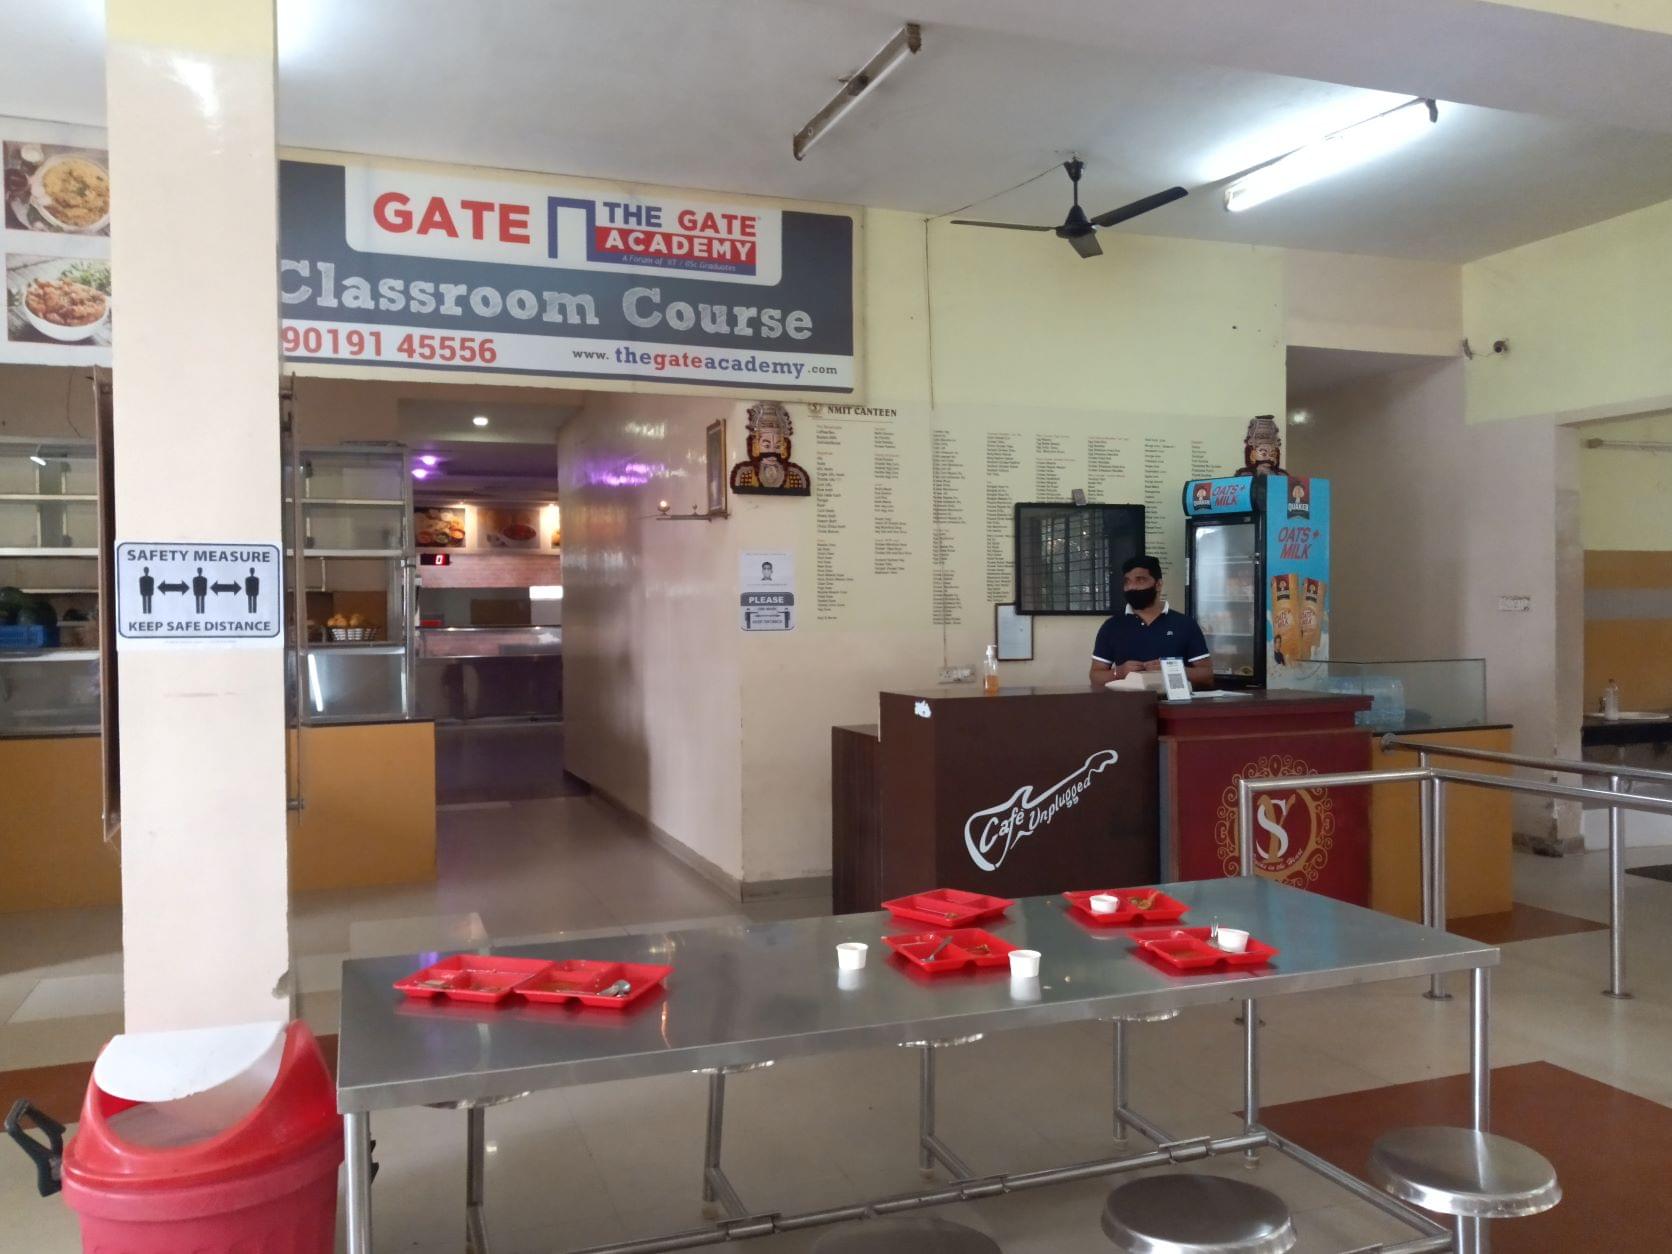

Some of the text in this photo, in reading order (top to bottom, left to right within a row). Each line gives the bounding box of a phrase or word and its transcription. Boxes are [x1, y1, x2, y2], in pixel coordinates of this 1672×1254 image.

[372, 192, 531, 245] GATE
[603, 202, 756, 238] THE GATE
[605, 229, 752, 261] ACADEMY
[281, 258, 814, 341] Classroom Course
[282, 325, 497, 364] 90191 45556
[827, 406, 853, 415] NMIT
[854, 407, 897, 417] CANTEEN
[1215, 495, 1237, 507] MILK
[1288, 503, 1309, 512] QUAKER
[127, 549, 271, 563] SAFETY MEASURE
[1280, 543, 1313, 560] MILK
[748, 596, 785, 604] PLEASE
[128, 621, 271, 632] KEEP SAFE DISTANCE
[1029, 773, 1092, 830] Unplugged
